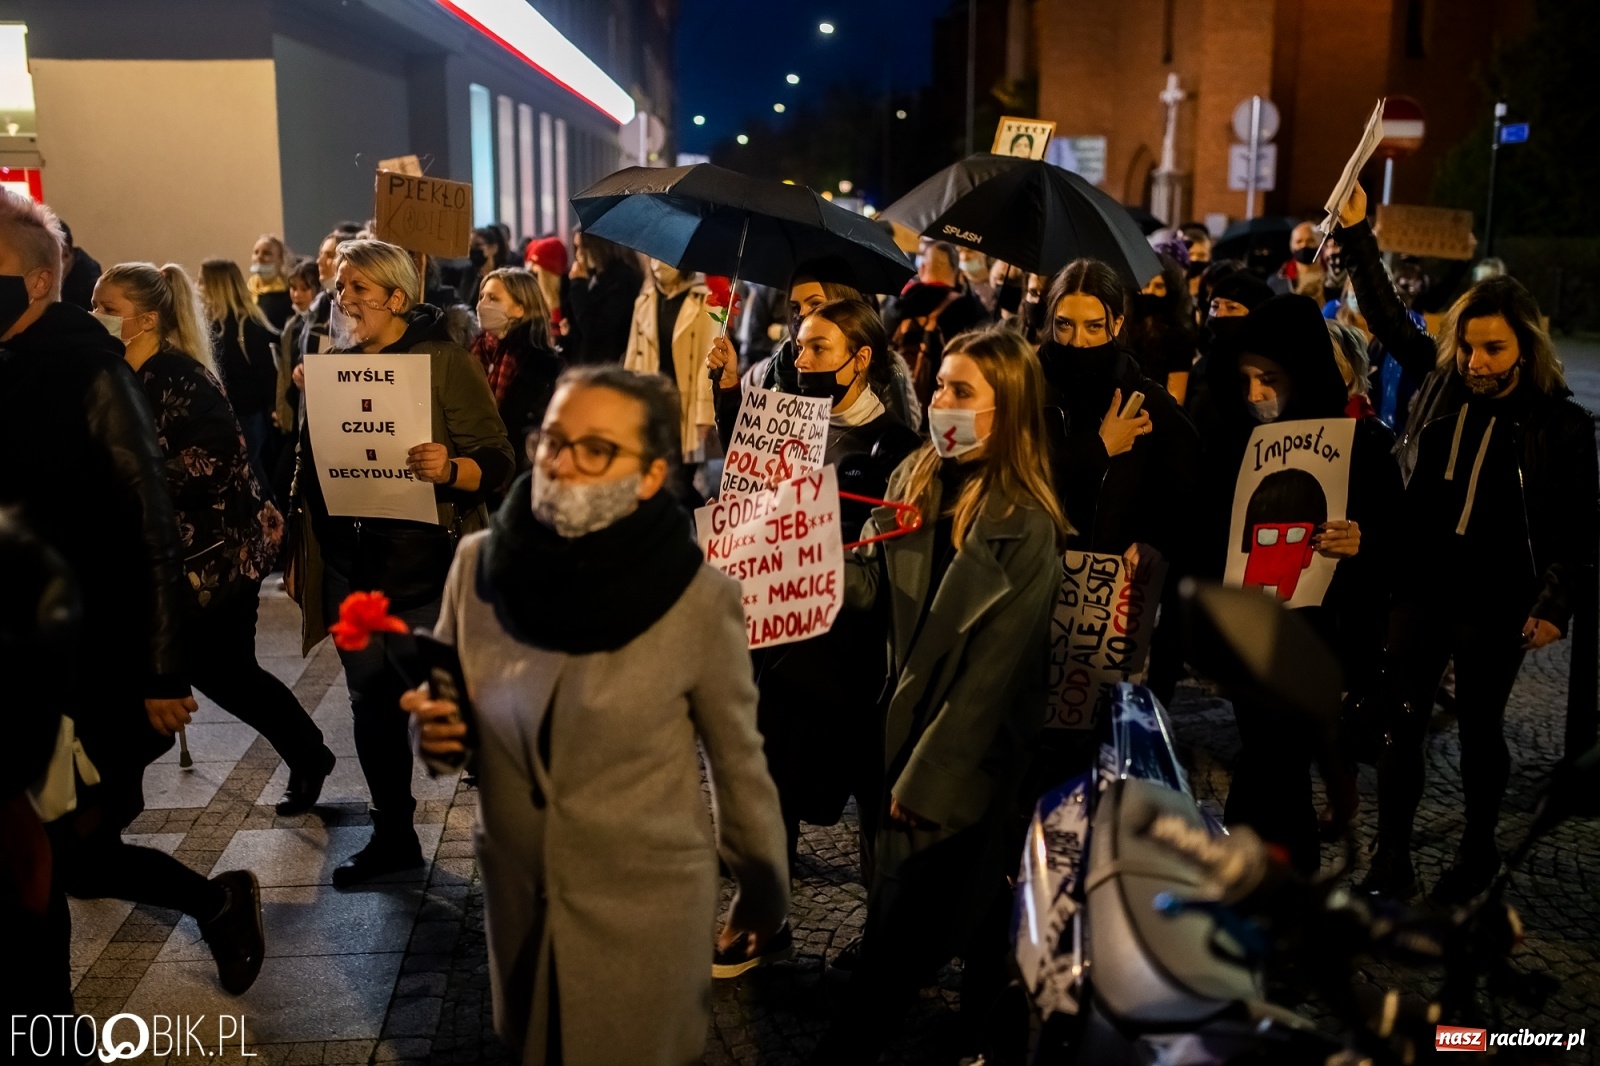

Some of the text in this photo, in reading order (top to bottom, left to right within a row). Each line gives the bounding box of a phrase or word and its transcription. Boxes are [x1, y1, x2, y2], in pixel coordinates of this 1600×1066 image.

[389, 175, 466, 209] PIEKŁO
[942, 224, 984, 244] SPLASH
[337, 367, 395, 385] MYŚLĘ
[746, 391, 767, 411] NA
[776, 396, 816, 421] GÓRZE
[341, 421, 396, 436] CZUJĘ
[740, 412, 761, 431] NA
[766, 418, 807, 440] DOLE
[734, 431, 823, 464] NAGIE MIECZ
[1253, 426, 1341, 471] Impostor
[328, 468, 414, 482] DECYDUJĘ
[722, 472, 765, 494] JEDN
[791, 473, 824, 505] TY
[799, 543, 823, 567] MI
[768, 570, 837, 605] MACICĘ
[1071, 622, 1108, 669] ALE
[1058, 668, 1091, 727] GOD
